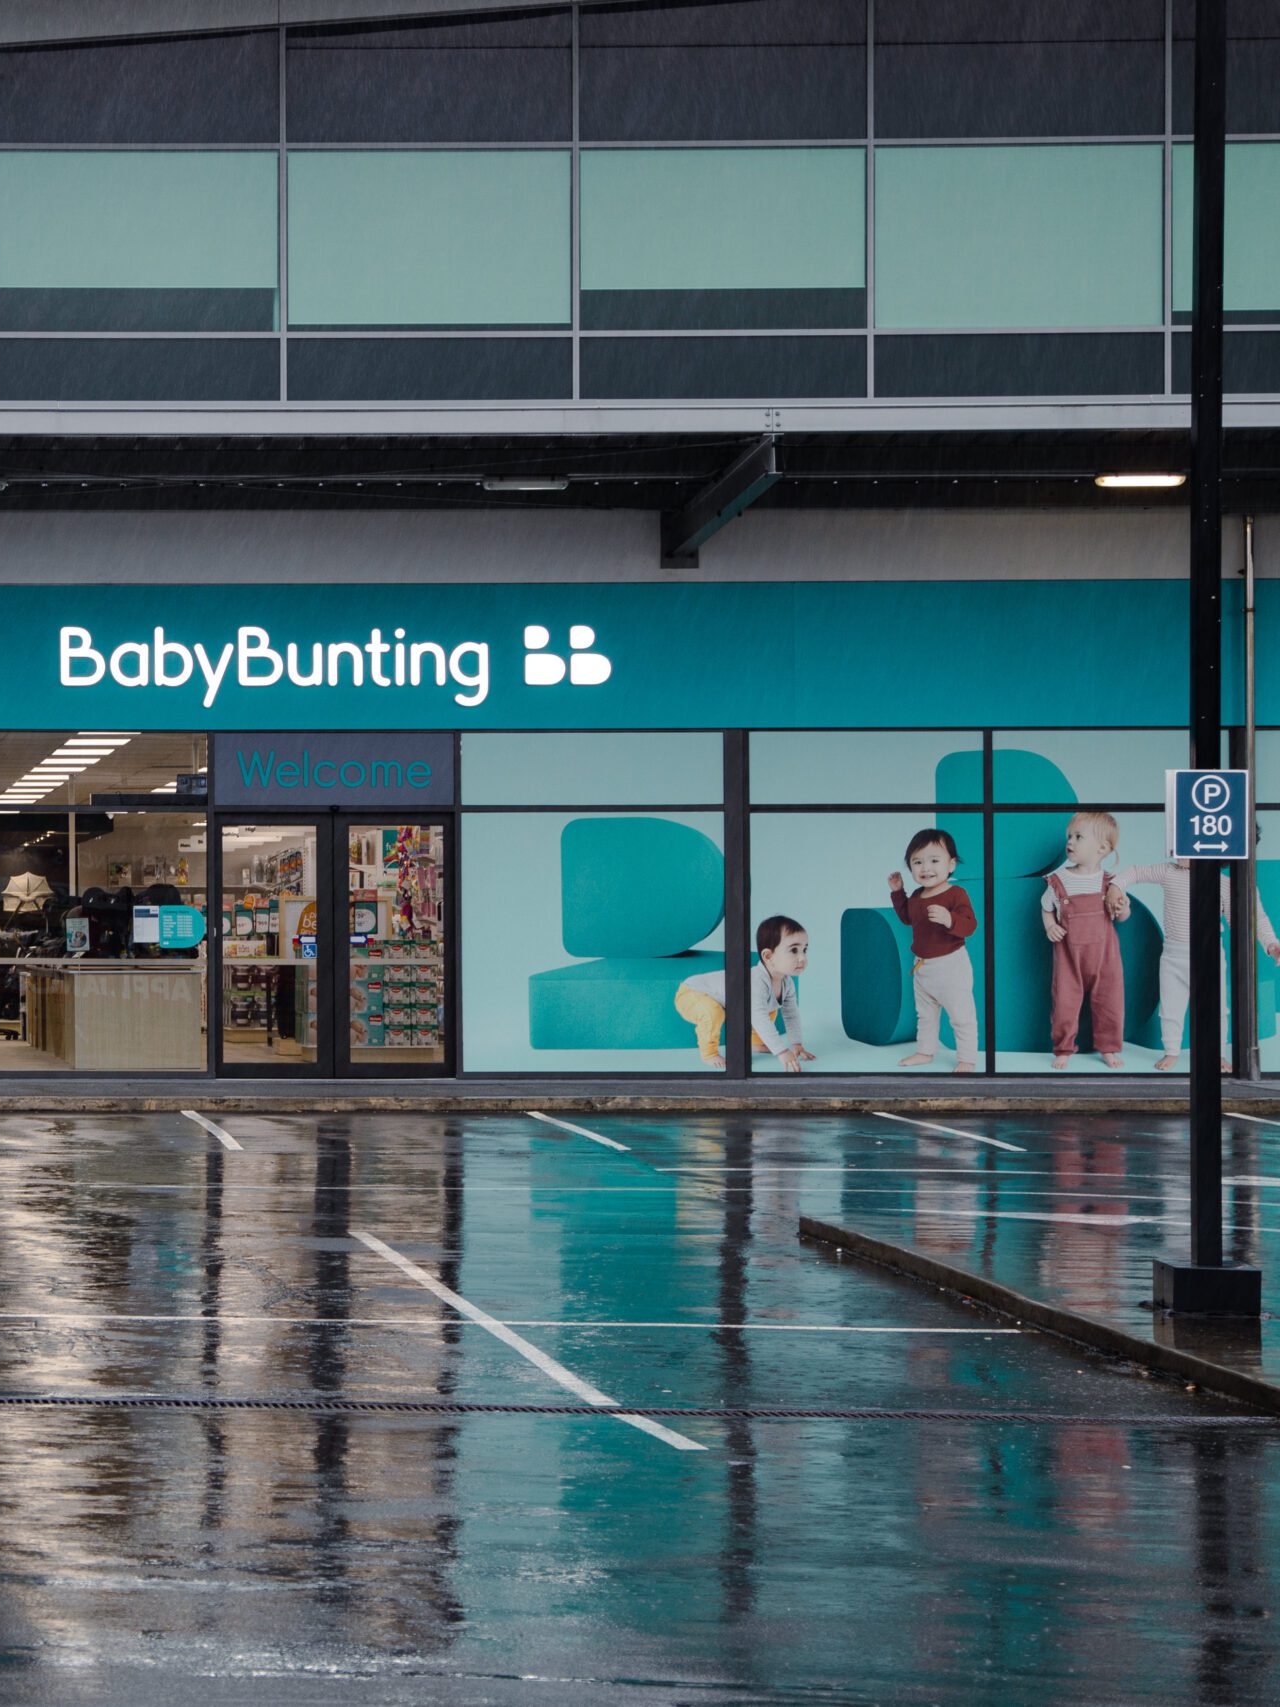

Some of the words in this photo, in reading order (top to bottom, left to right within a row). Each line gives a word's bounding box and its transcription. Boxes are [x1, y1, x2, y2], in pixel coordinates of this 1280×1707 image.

[59, 626, 489, 708] BabyBunting
[236, 750, 432, 788] Welcome
[1189, 815, 1232, 836] 180
